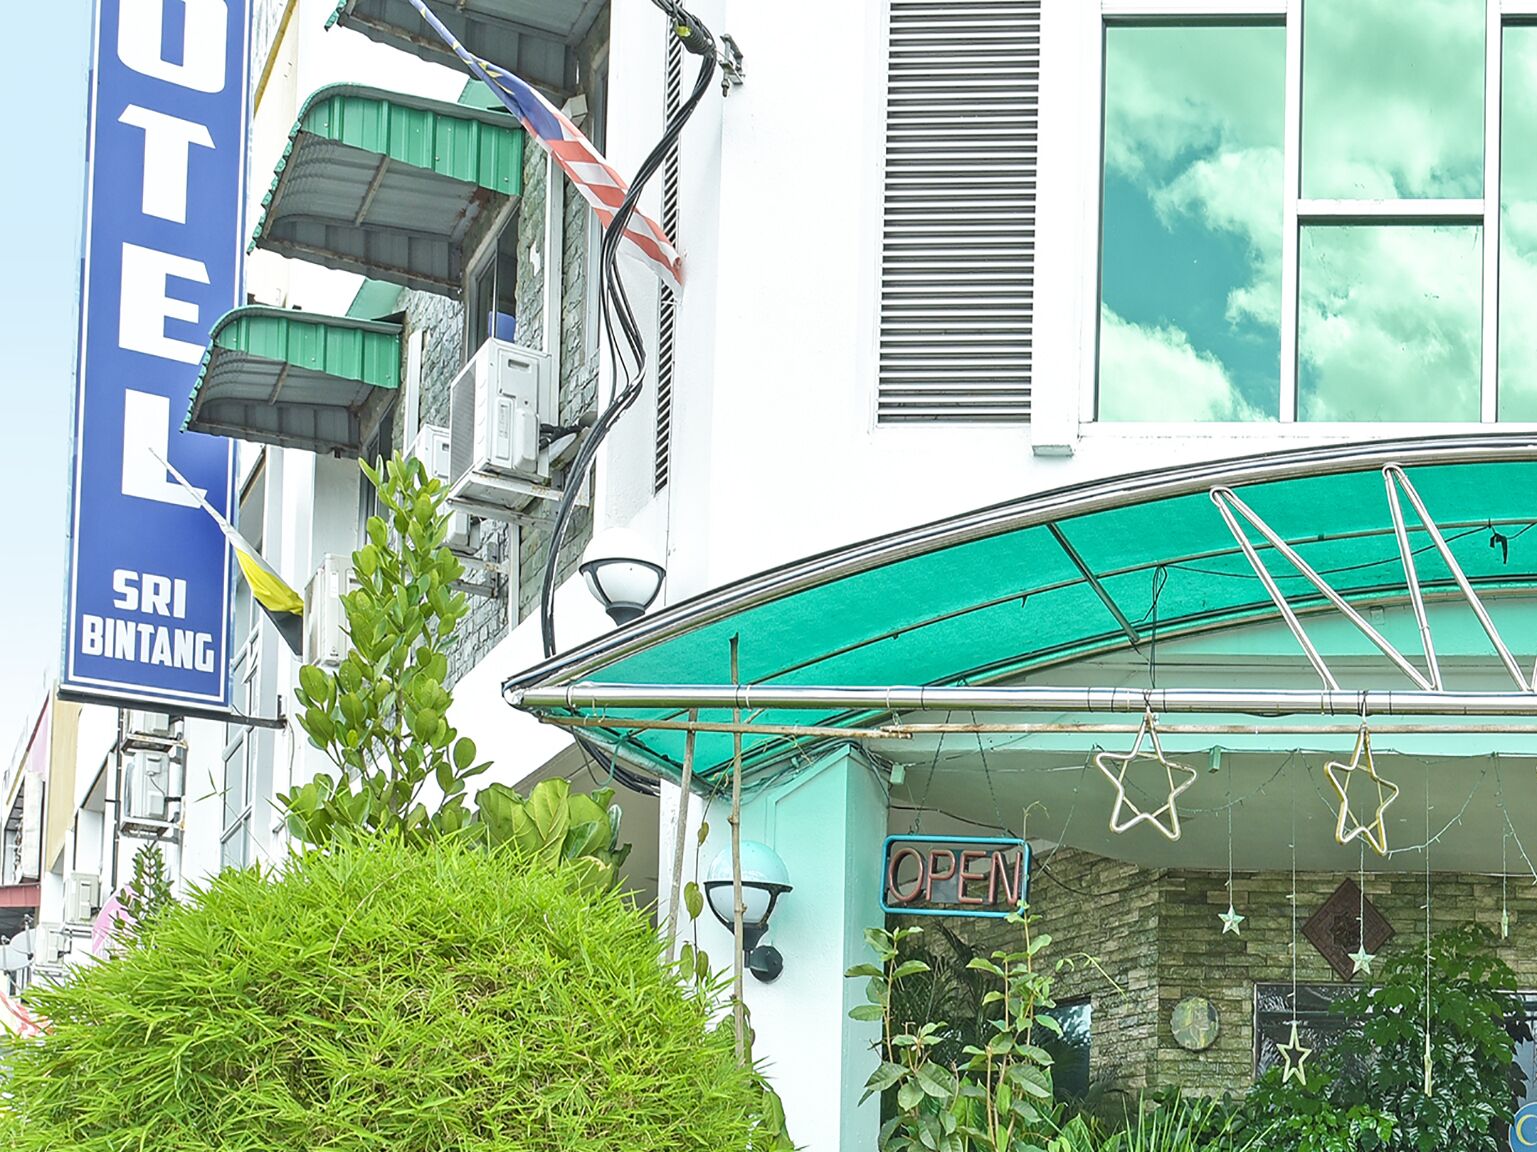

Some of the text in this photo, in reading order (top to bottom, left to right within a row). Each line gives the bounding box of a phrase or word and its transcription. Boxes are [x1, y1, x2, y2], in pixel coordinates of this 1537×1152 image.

[113, 568, 187, 619] SRI
[81, 614, 215, 673] BINTANG
[888, 847, 1022, 906] OPEN
